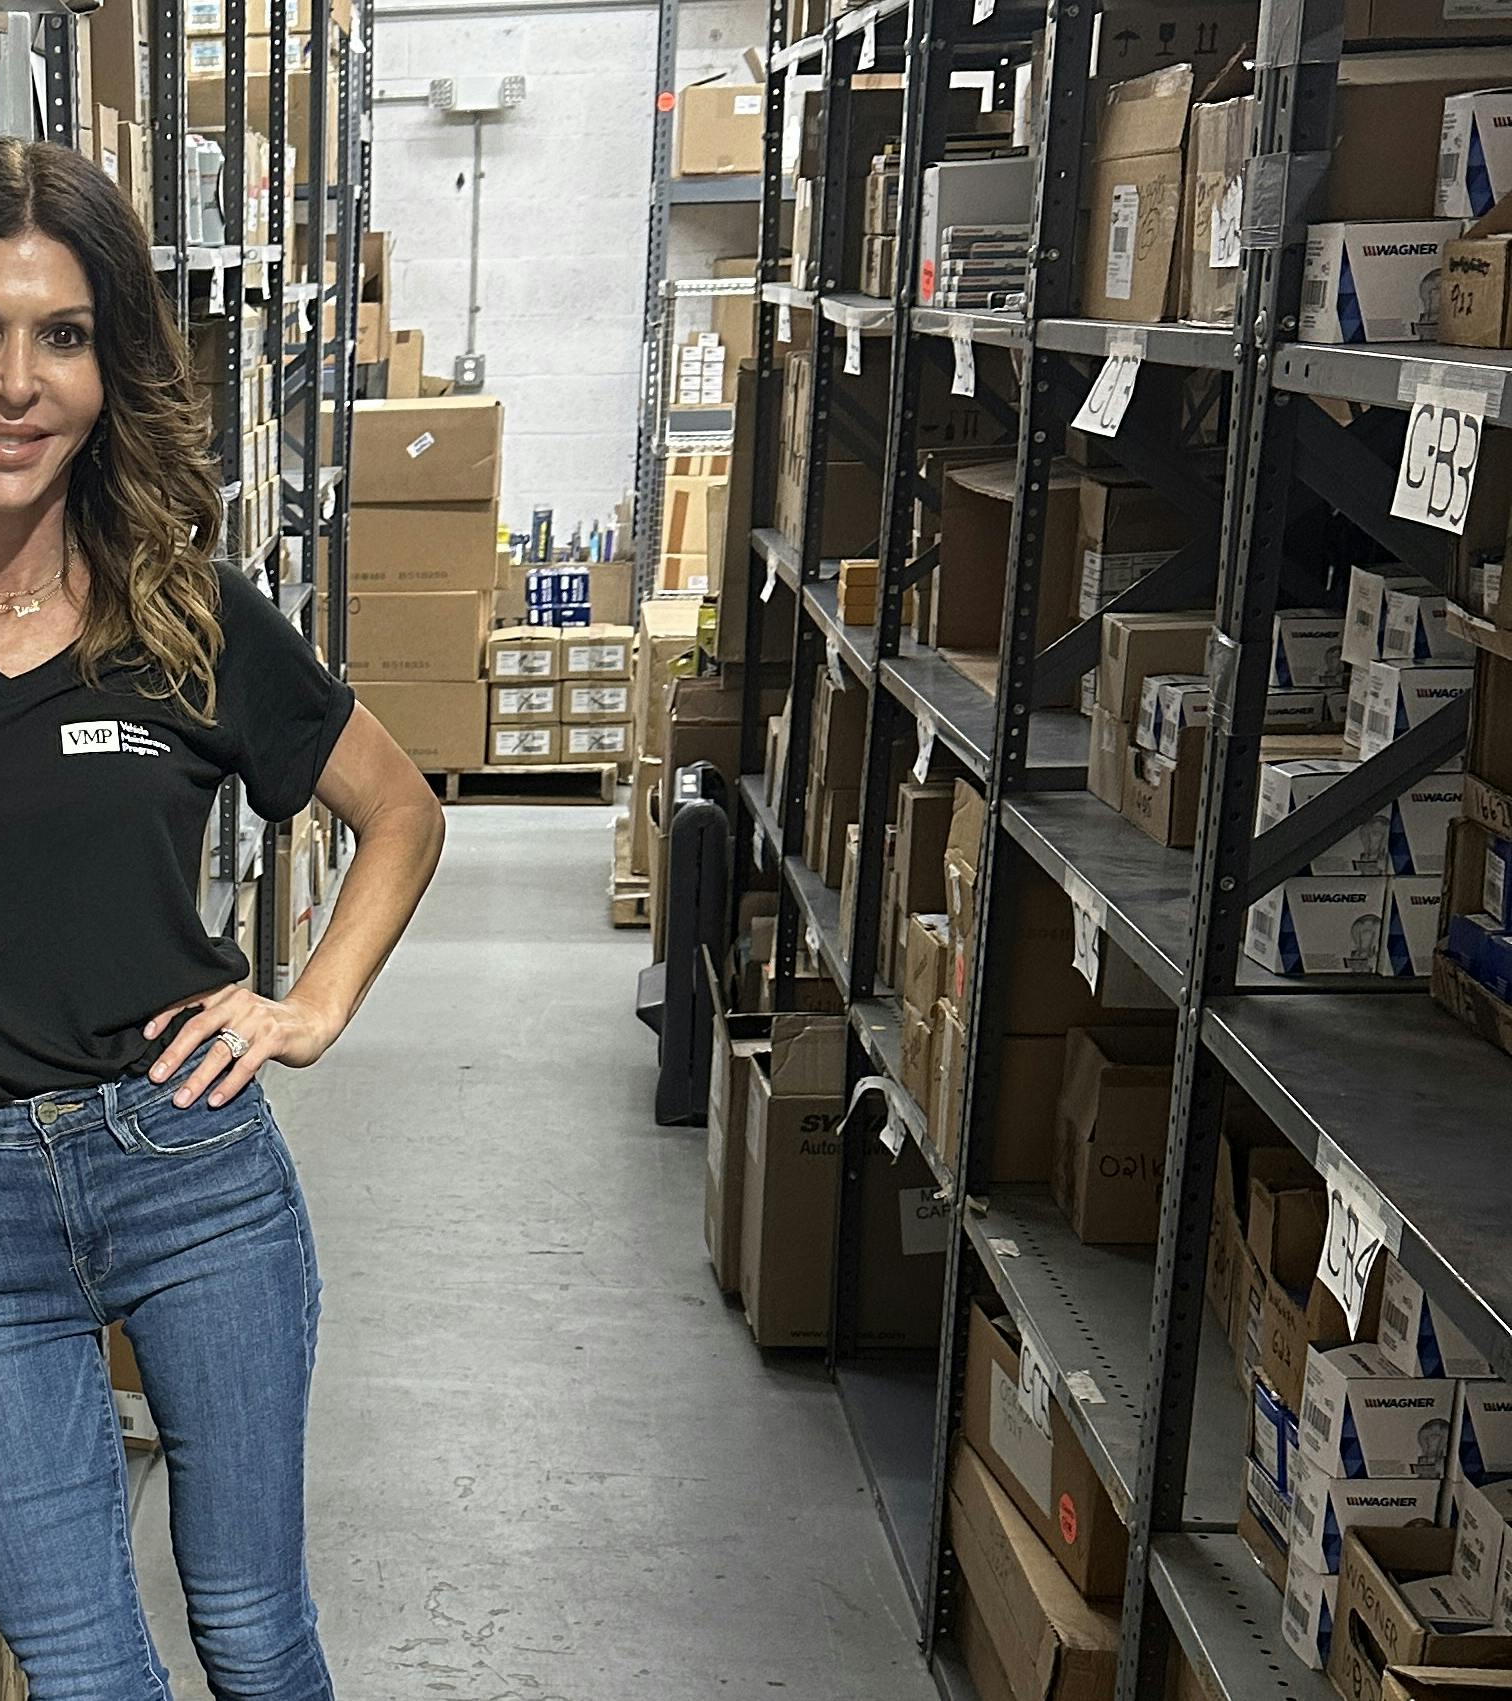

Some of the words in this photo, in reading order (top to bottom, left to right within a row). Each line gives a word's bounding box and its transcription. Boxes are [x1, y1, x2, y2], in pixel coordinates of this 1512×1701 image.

[1373, 243, 1439, 257] WAGNER
[68, 728, 113, 746] VMP
[1424, 792, 1464, 803] WAGN
[1311, 893, 1367, 904] WAGNER
[1375, 1397, 1435, 1408] WAGNER
[1357, 1496, 1417, 1507] WAGNER
